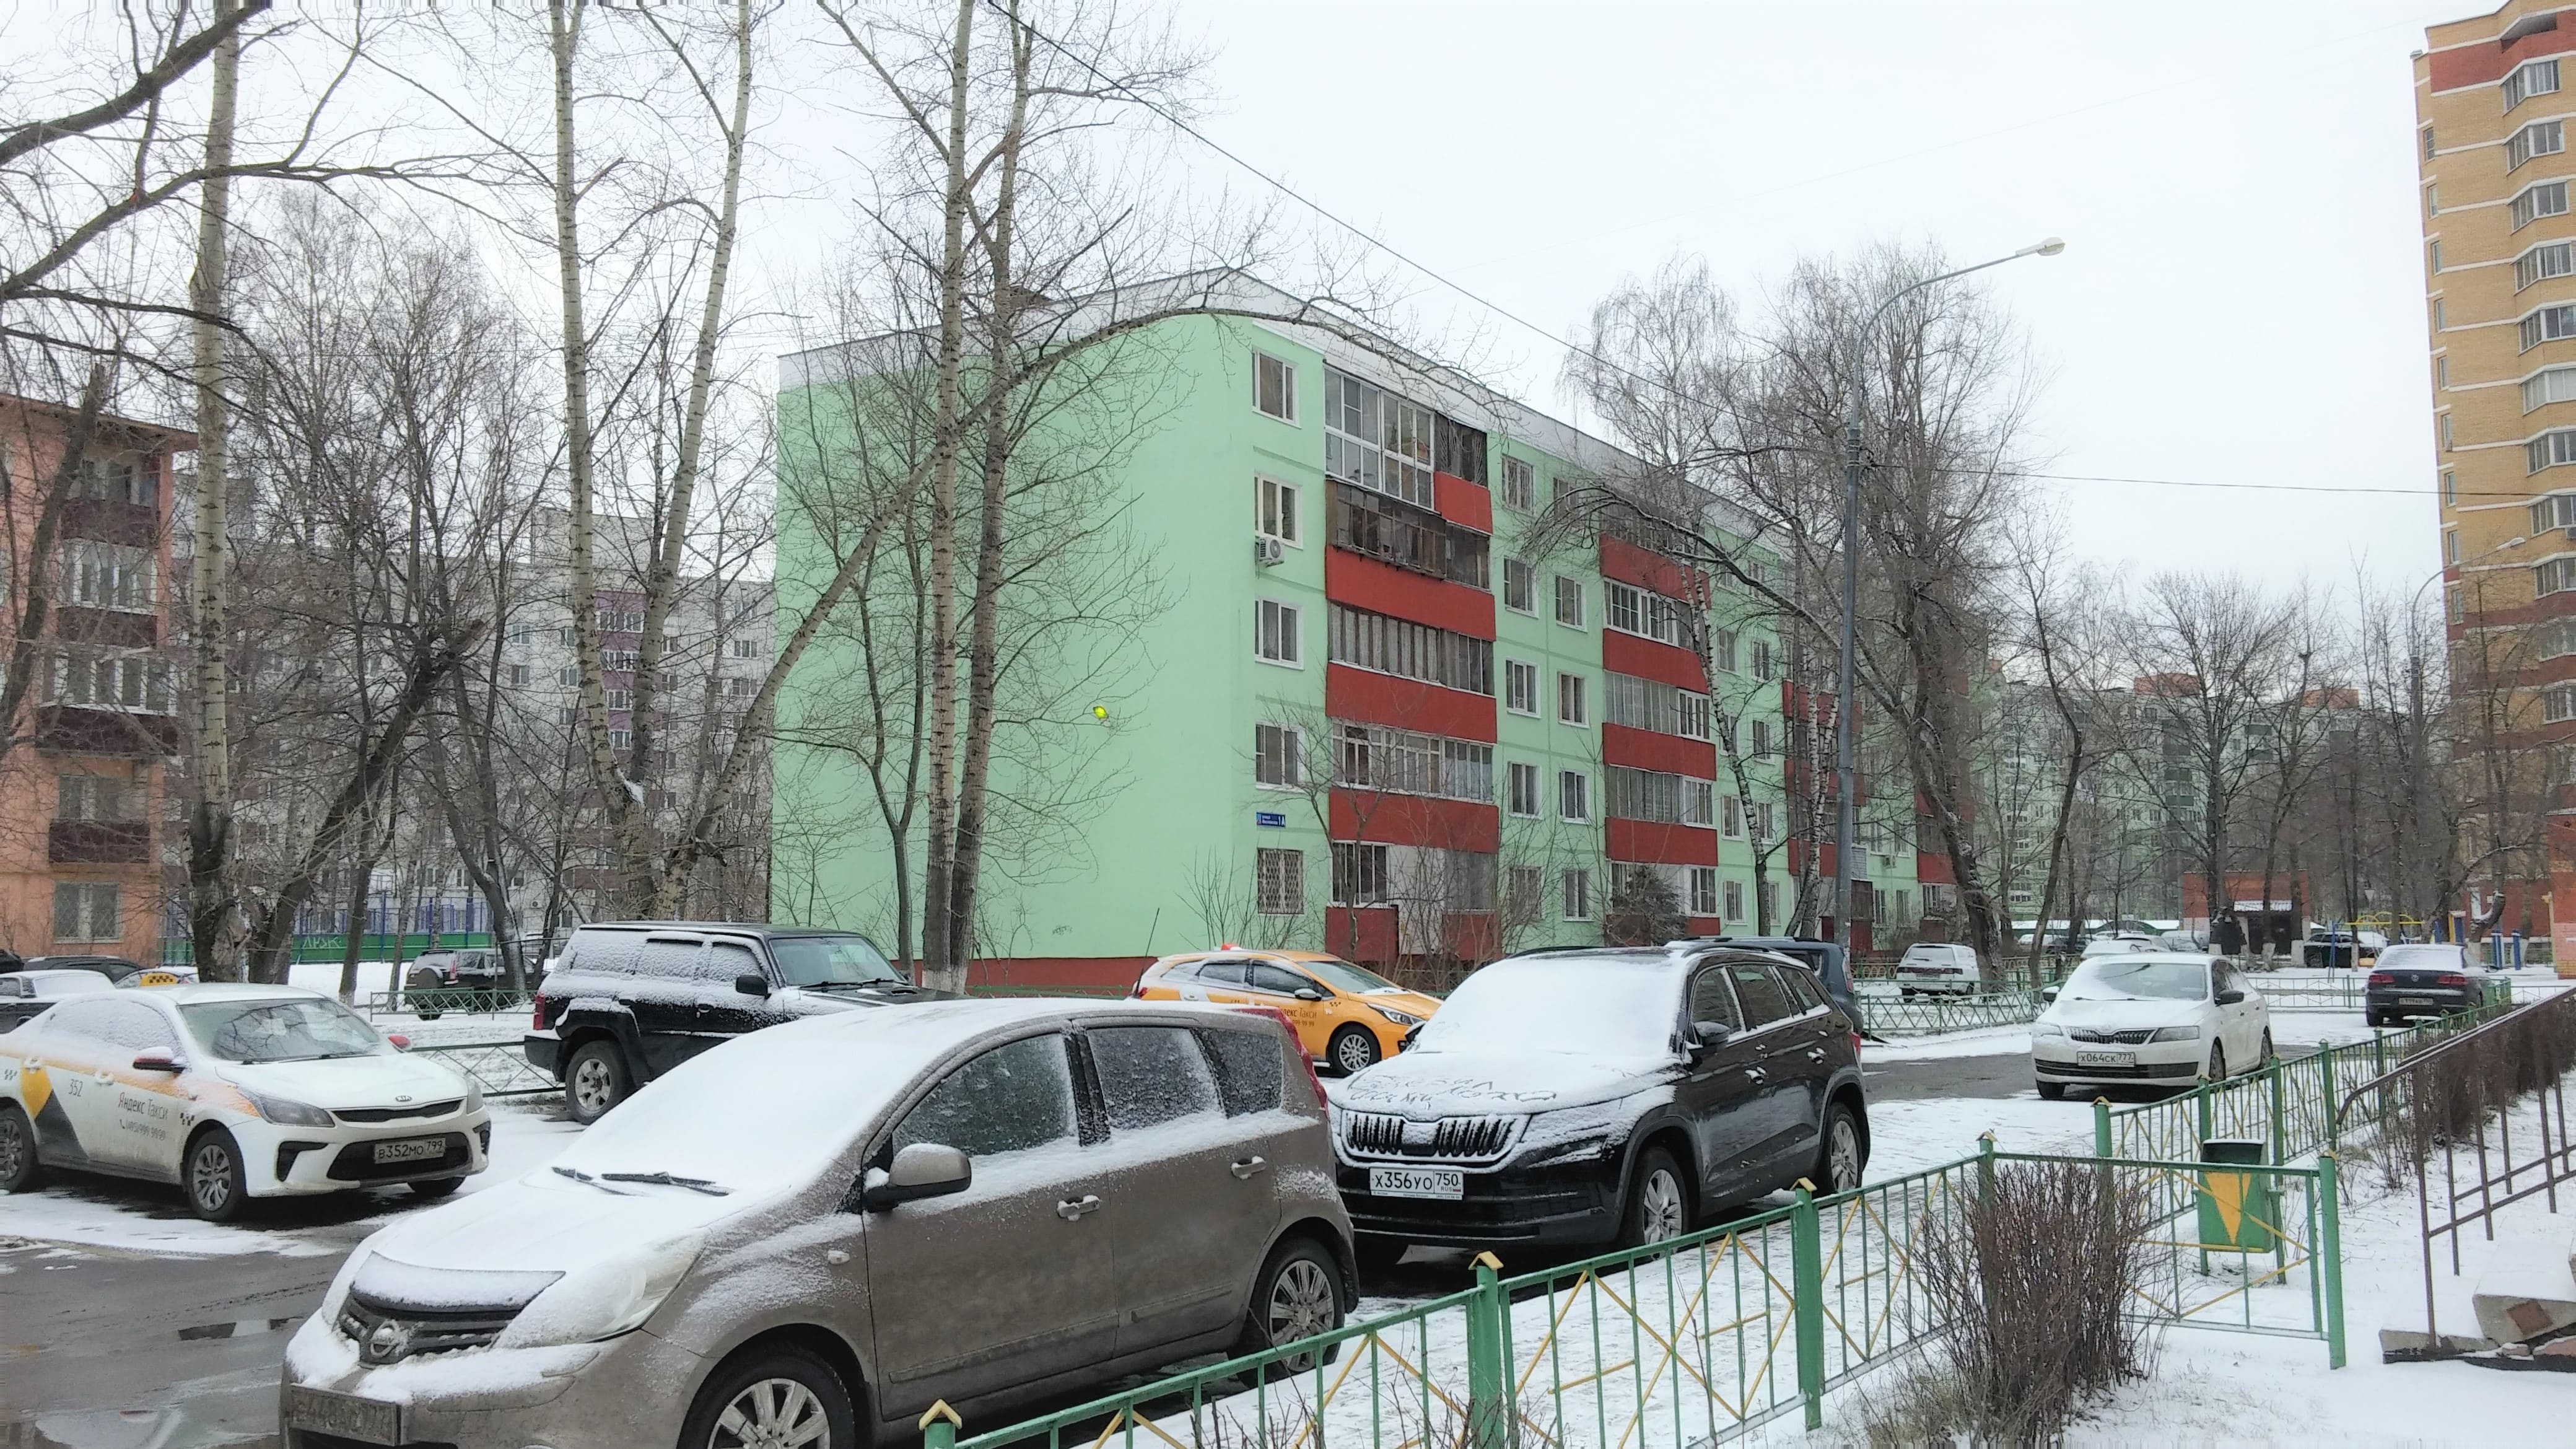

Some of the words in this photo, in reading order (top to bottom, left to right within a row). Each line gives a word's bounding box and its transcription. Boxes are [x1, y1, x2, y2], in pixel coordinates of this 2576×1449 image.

[1299, 1007, 1317, 1018] Такси
[69, 1079, 83, 1097] 352
[118, 1092, 145, 1114] Яндекс
[147, 1099, 168, 1121] Такси
[1435, 1173, 1459, 1186] 750
